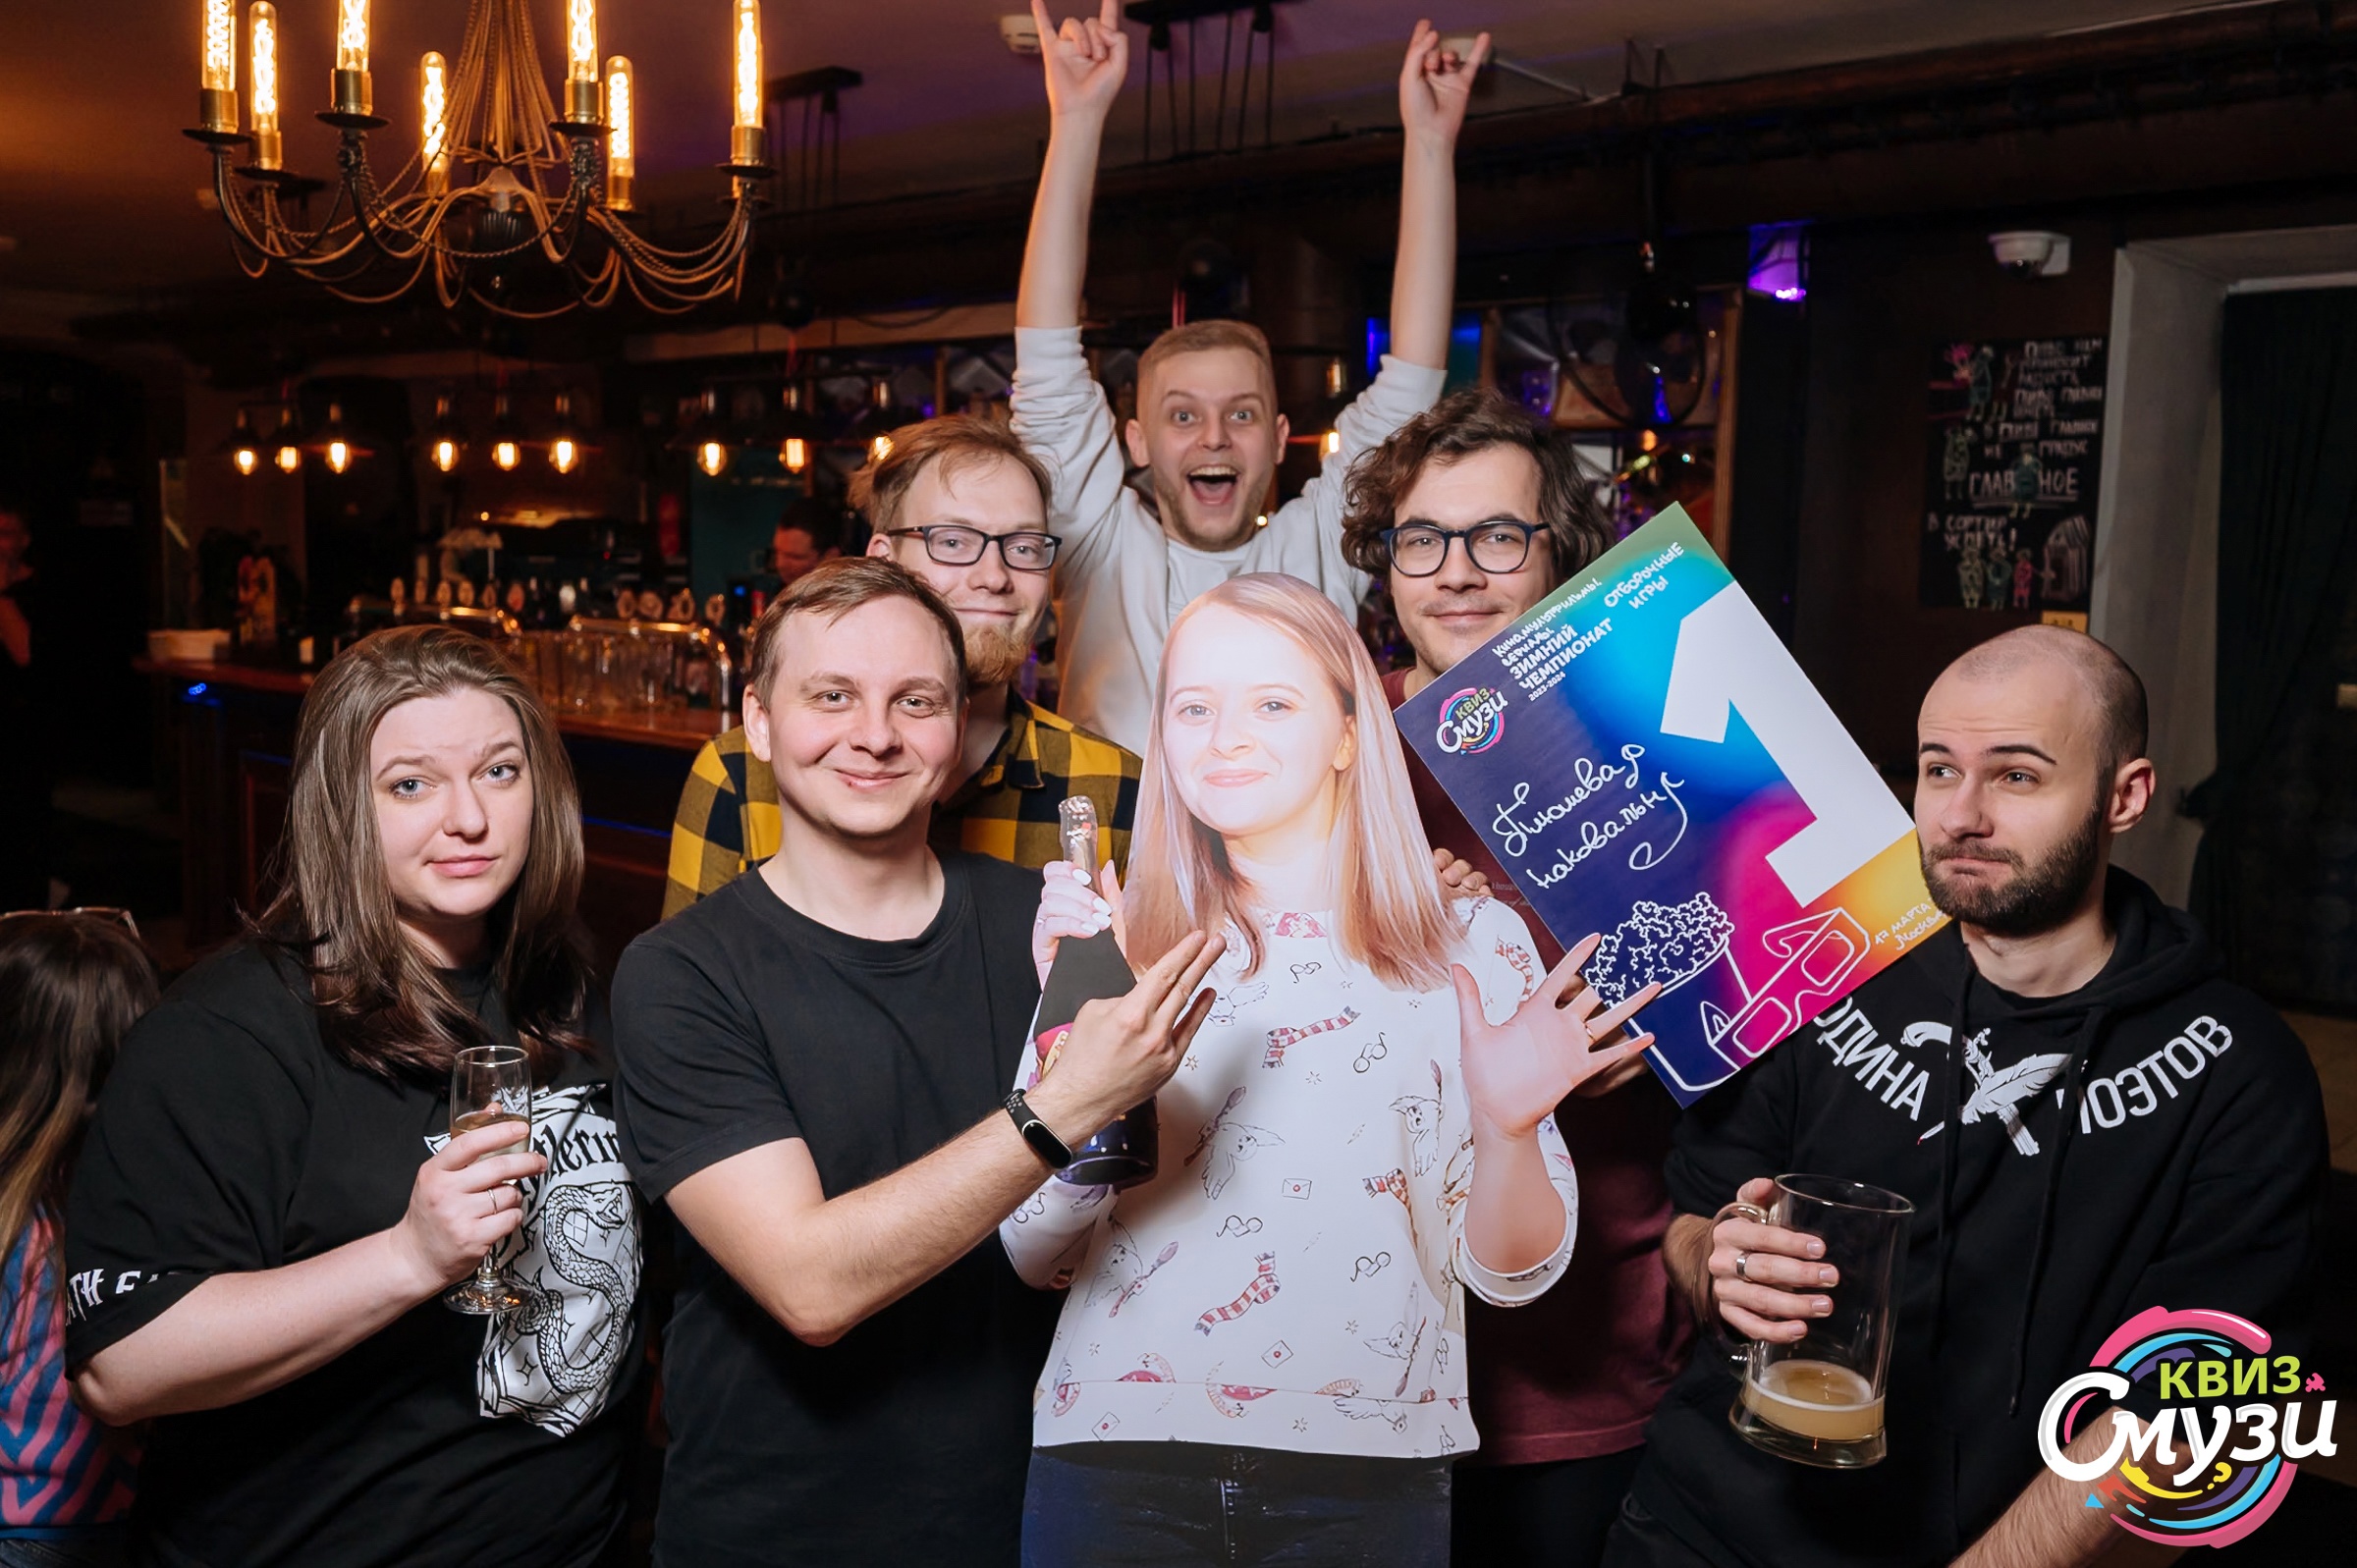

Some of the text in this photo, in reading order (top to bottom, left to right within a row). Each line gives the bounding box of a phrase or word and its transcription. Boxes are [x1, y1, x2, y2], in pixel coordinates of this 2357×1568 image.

[1604, 542, 1684, 608] ОТБОРОЧНЫЕ
[1628, 575, 1669, 609] ИГРЫ
[1509, 623, 1578, 679] ЗИМНИЙ
[1519, 618, 1614, 690] ЧЕМПИОНАТ
[1455, 688, 1490, 720] КВИЗ
[1528, 672, 1566, 702] 2023-2024
[1436, 691, 1508, 753] Смузи
[1660, 580, 1916, 908] 1
[1813, 996, 1930, 1121] ОДИНА
